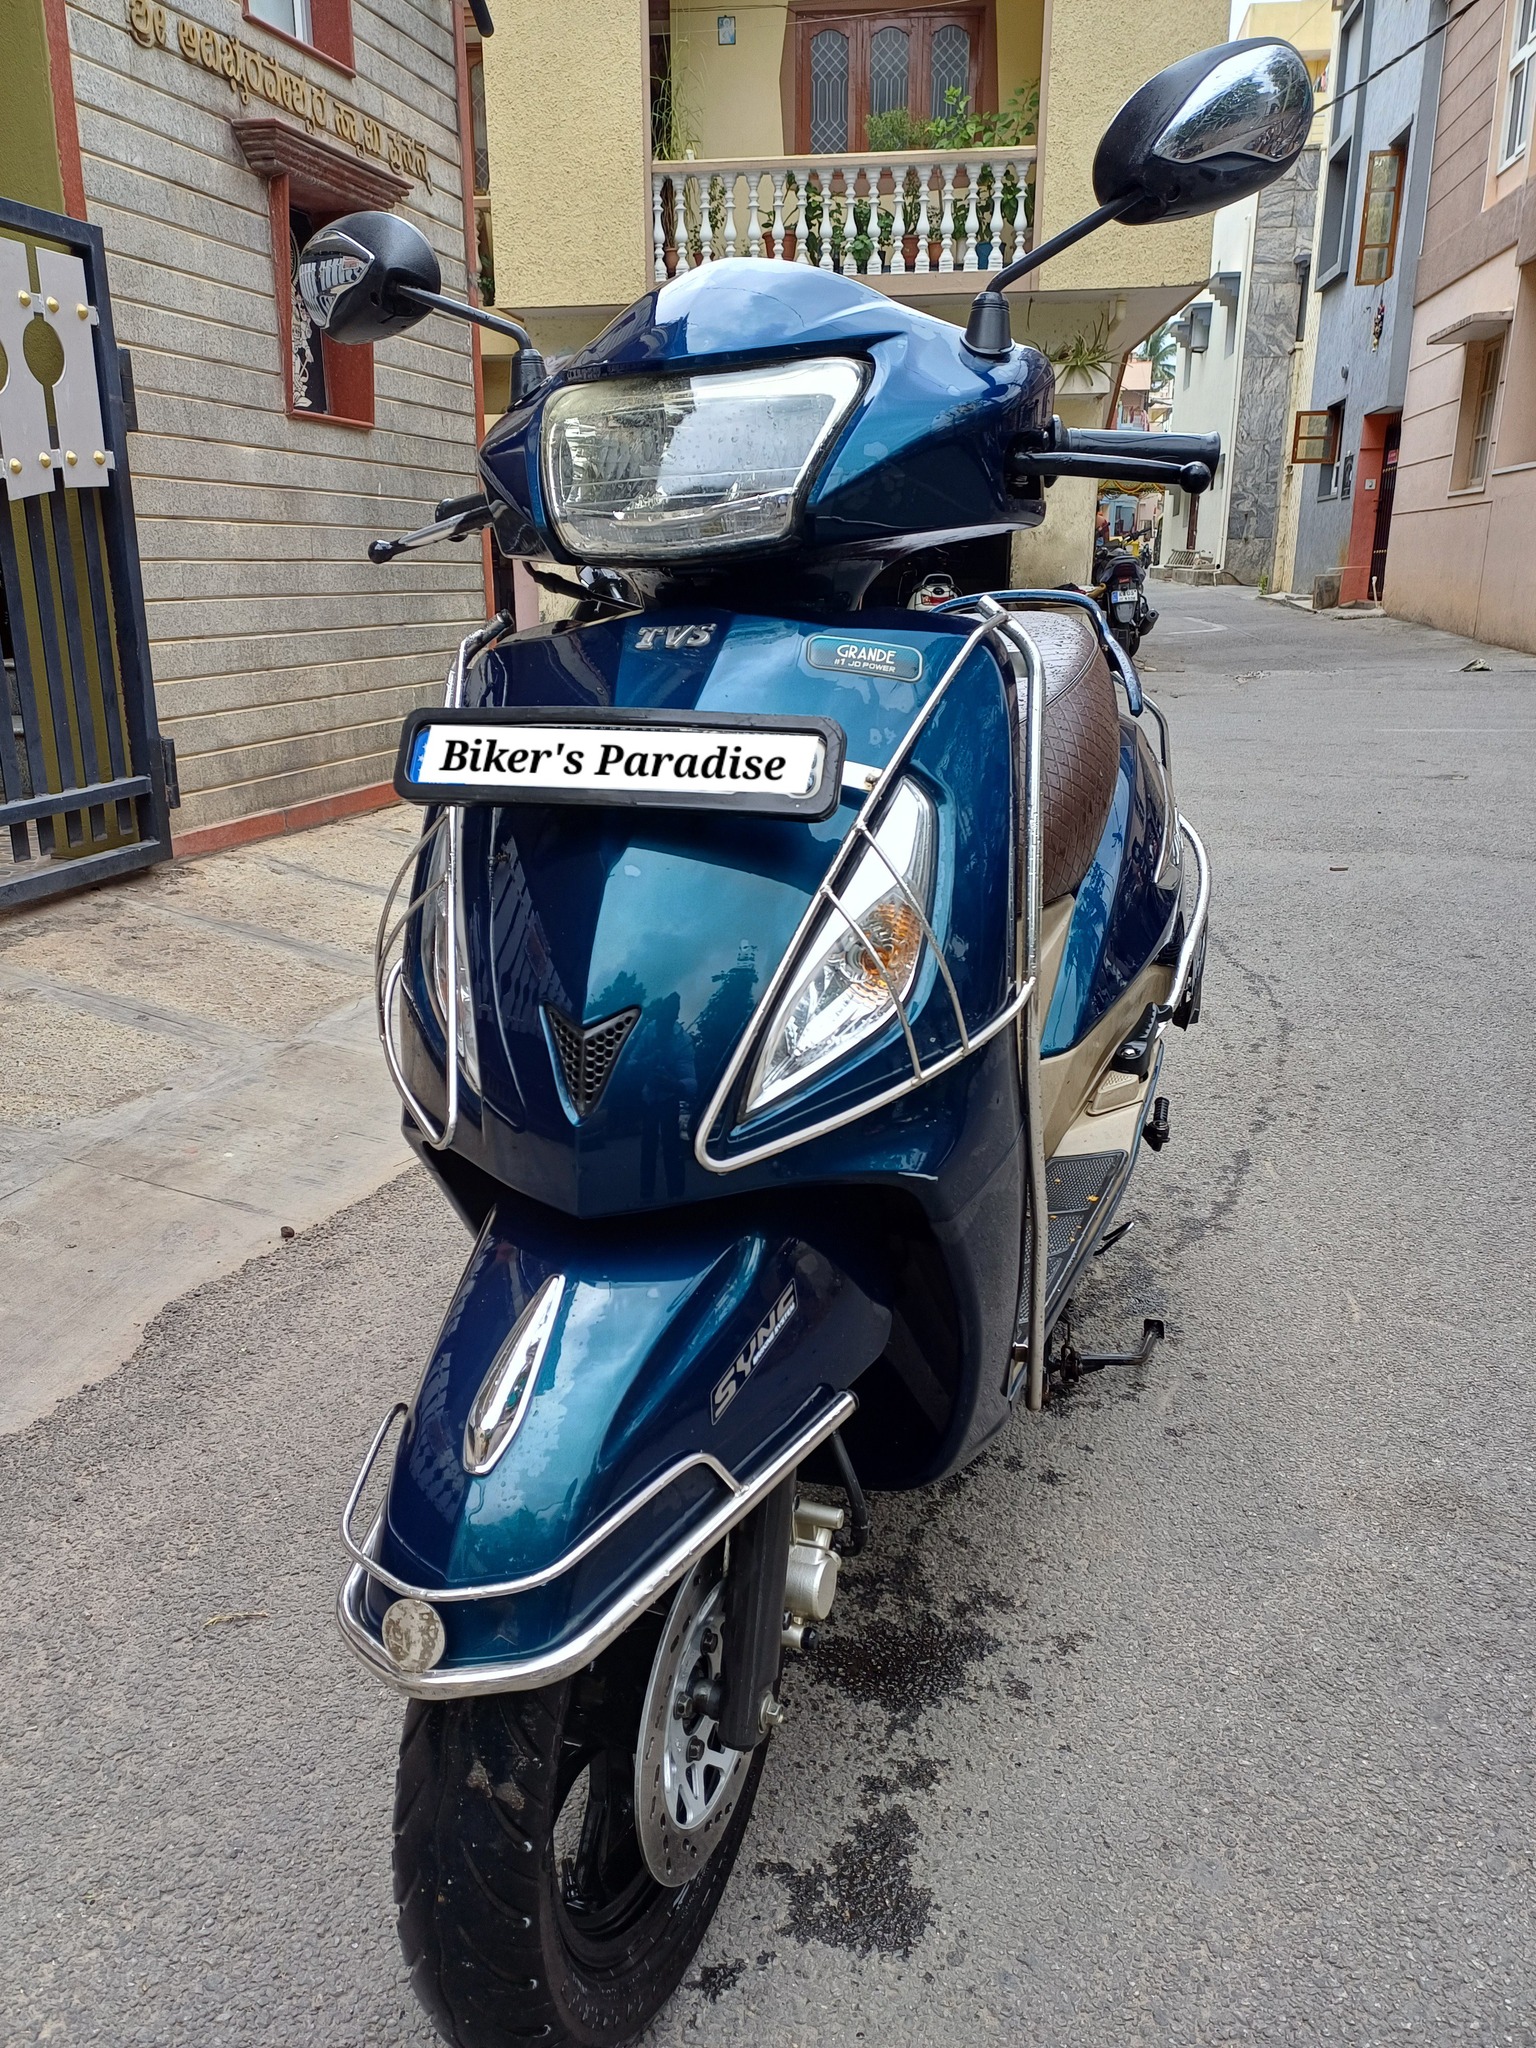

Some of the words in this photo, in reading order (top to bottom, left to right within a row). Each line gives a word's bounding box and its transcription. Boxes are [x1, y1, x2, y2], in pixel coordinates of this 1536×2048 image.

[635, 623, 717, 650] TVS
[836, 644, 897, 665] GRANDE
[862, 662, 896, 673] POWER
[715, 1284, 794, 1418] SYNC
